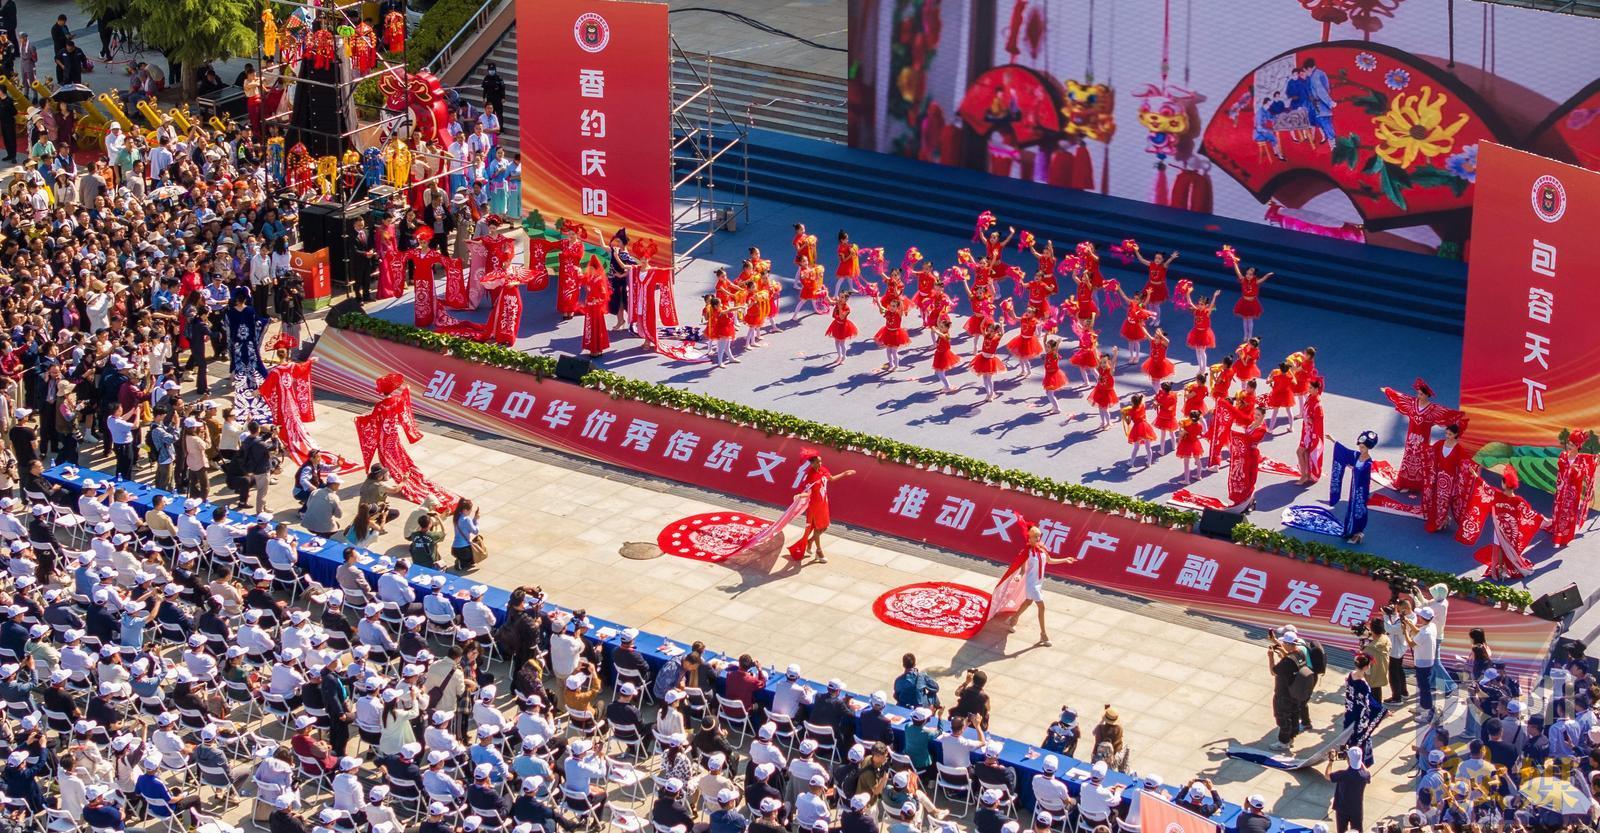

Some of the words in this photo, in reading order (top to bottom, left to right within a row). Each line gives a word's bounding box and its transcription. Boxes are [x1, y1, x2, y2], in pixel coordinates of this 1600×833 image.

[579, 68, 608, 217] 香约庆阳
[1522, 238, 1557, 412] 包容天下
[889, 484, 1376, 628] 推动文旅产业融合发展
